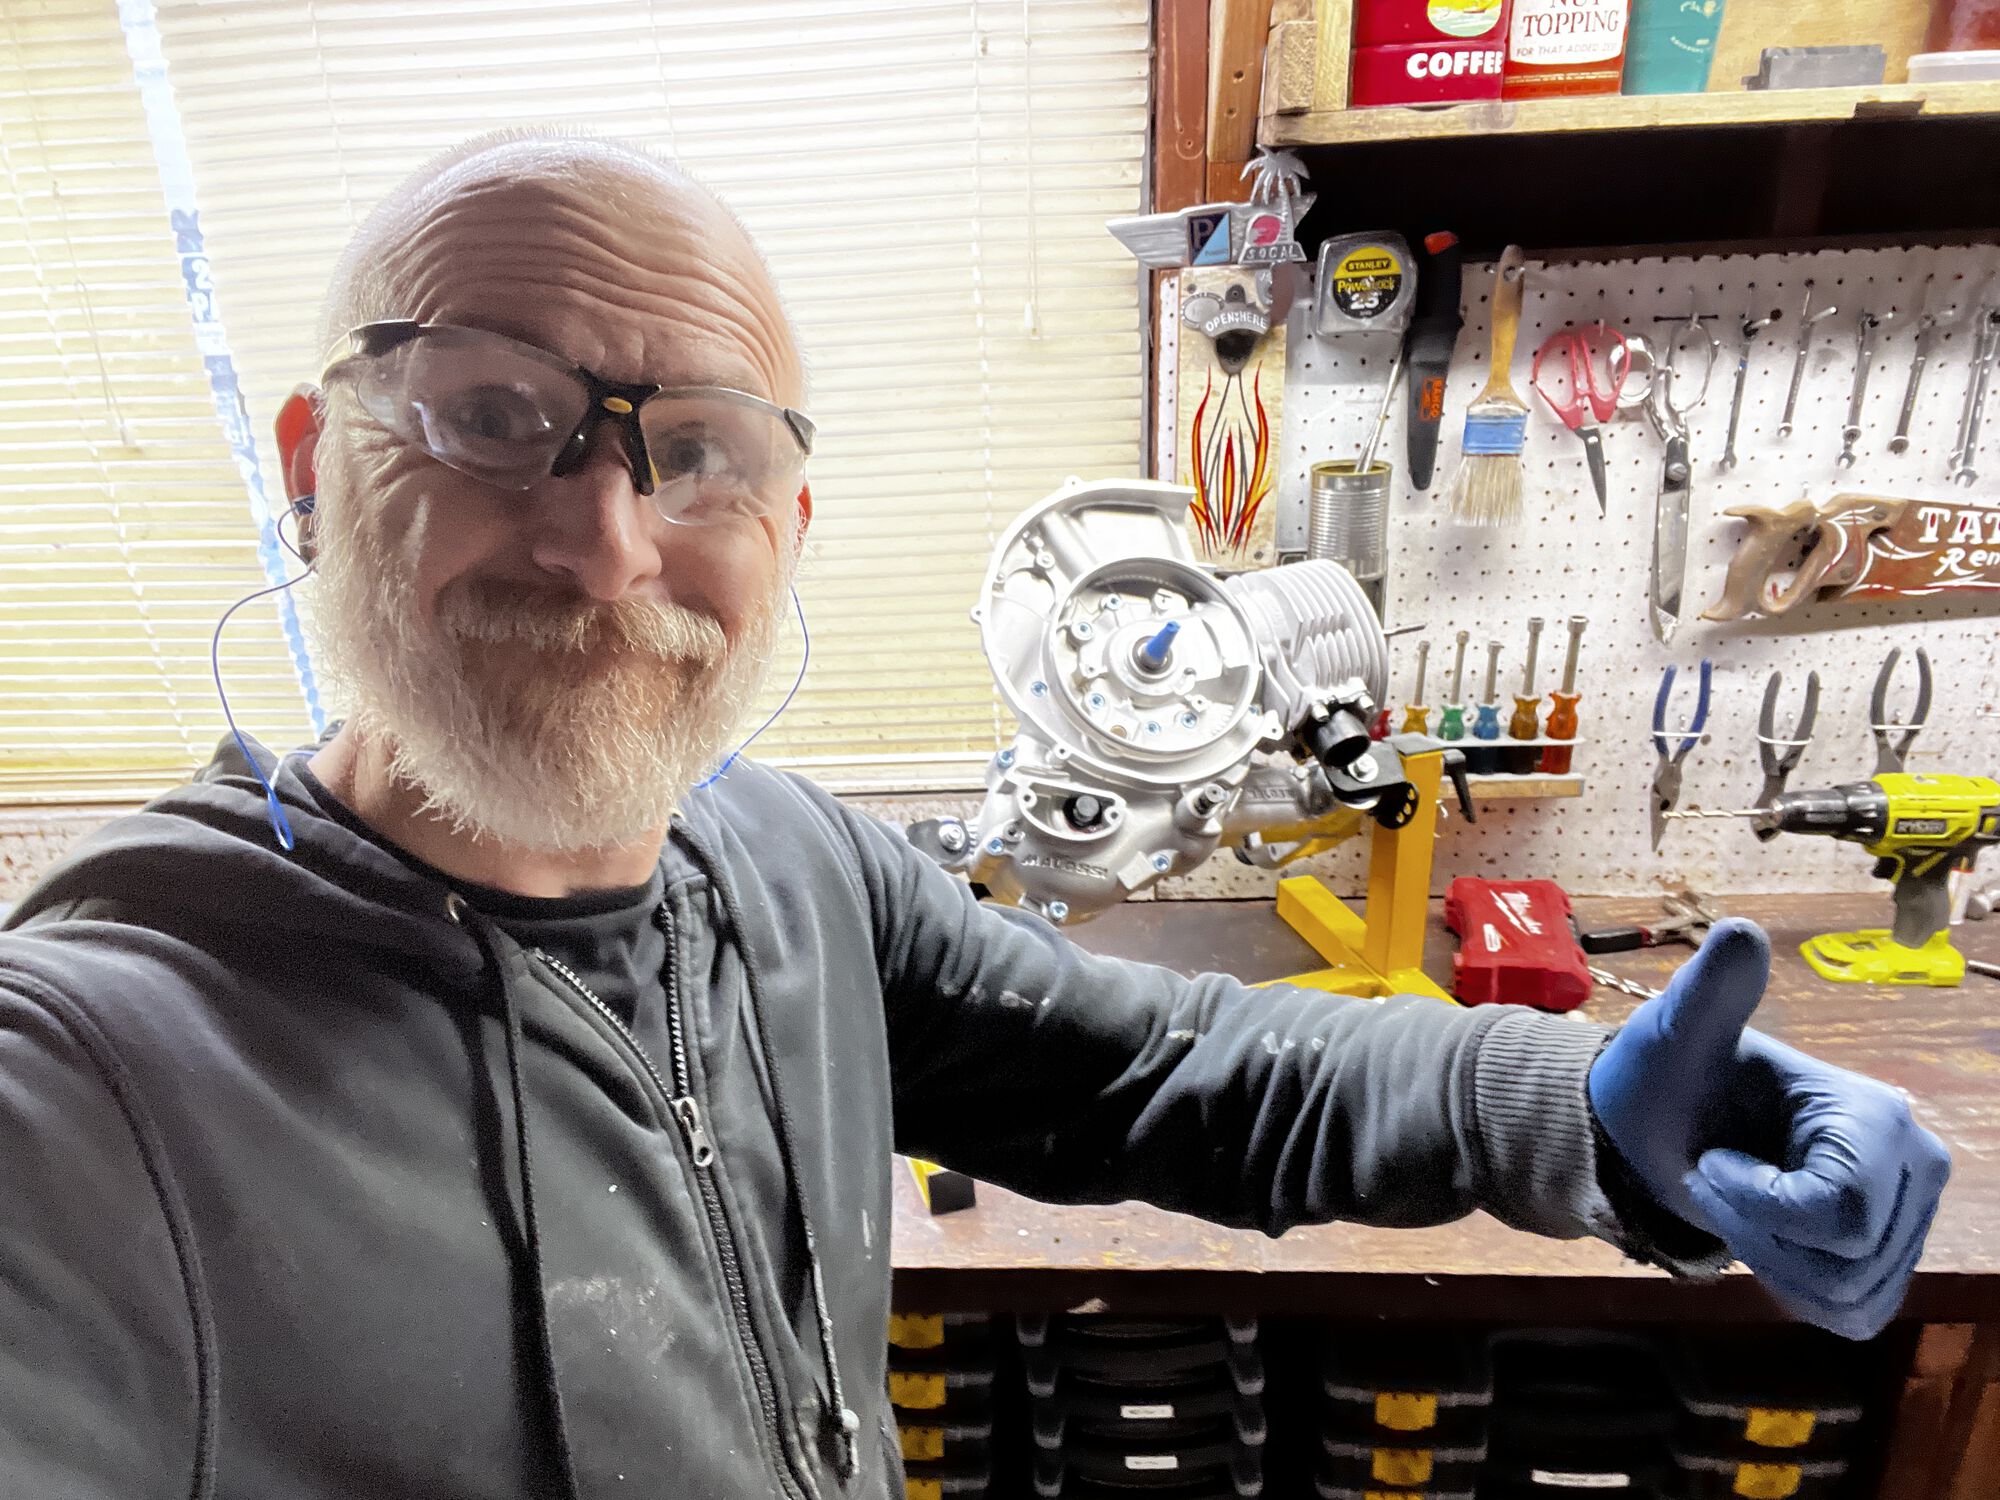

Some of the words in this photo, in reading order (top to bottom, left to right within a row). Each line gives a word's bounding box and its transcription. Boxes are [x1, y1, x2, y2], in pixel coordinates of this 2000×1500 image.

[1522, 10, 1619, 37] TOPPING
[1515, 47, 1534, 57] FOR
[1538, 45, 1563, 55] THAT
[1406, 51, 1503, 79] COFFEE
[1348, 260, 1389, 271] STANLEY
[1205, 311, 1235, 332] OPEN
[1239, 310, 1268, 329] HERE
